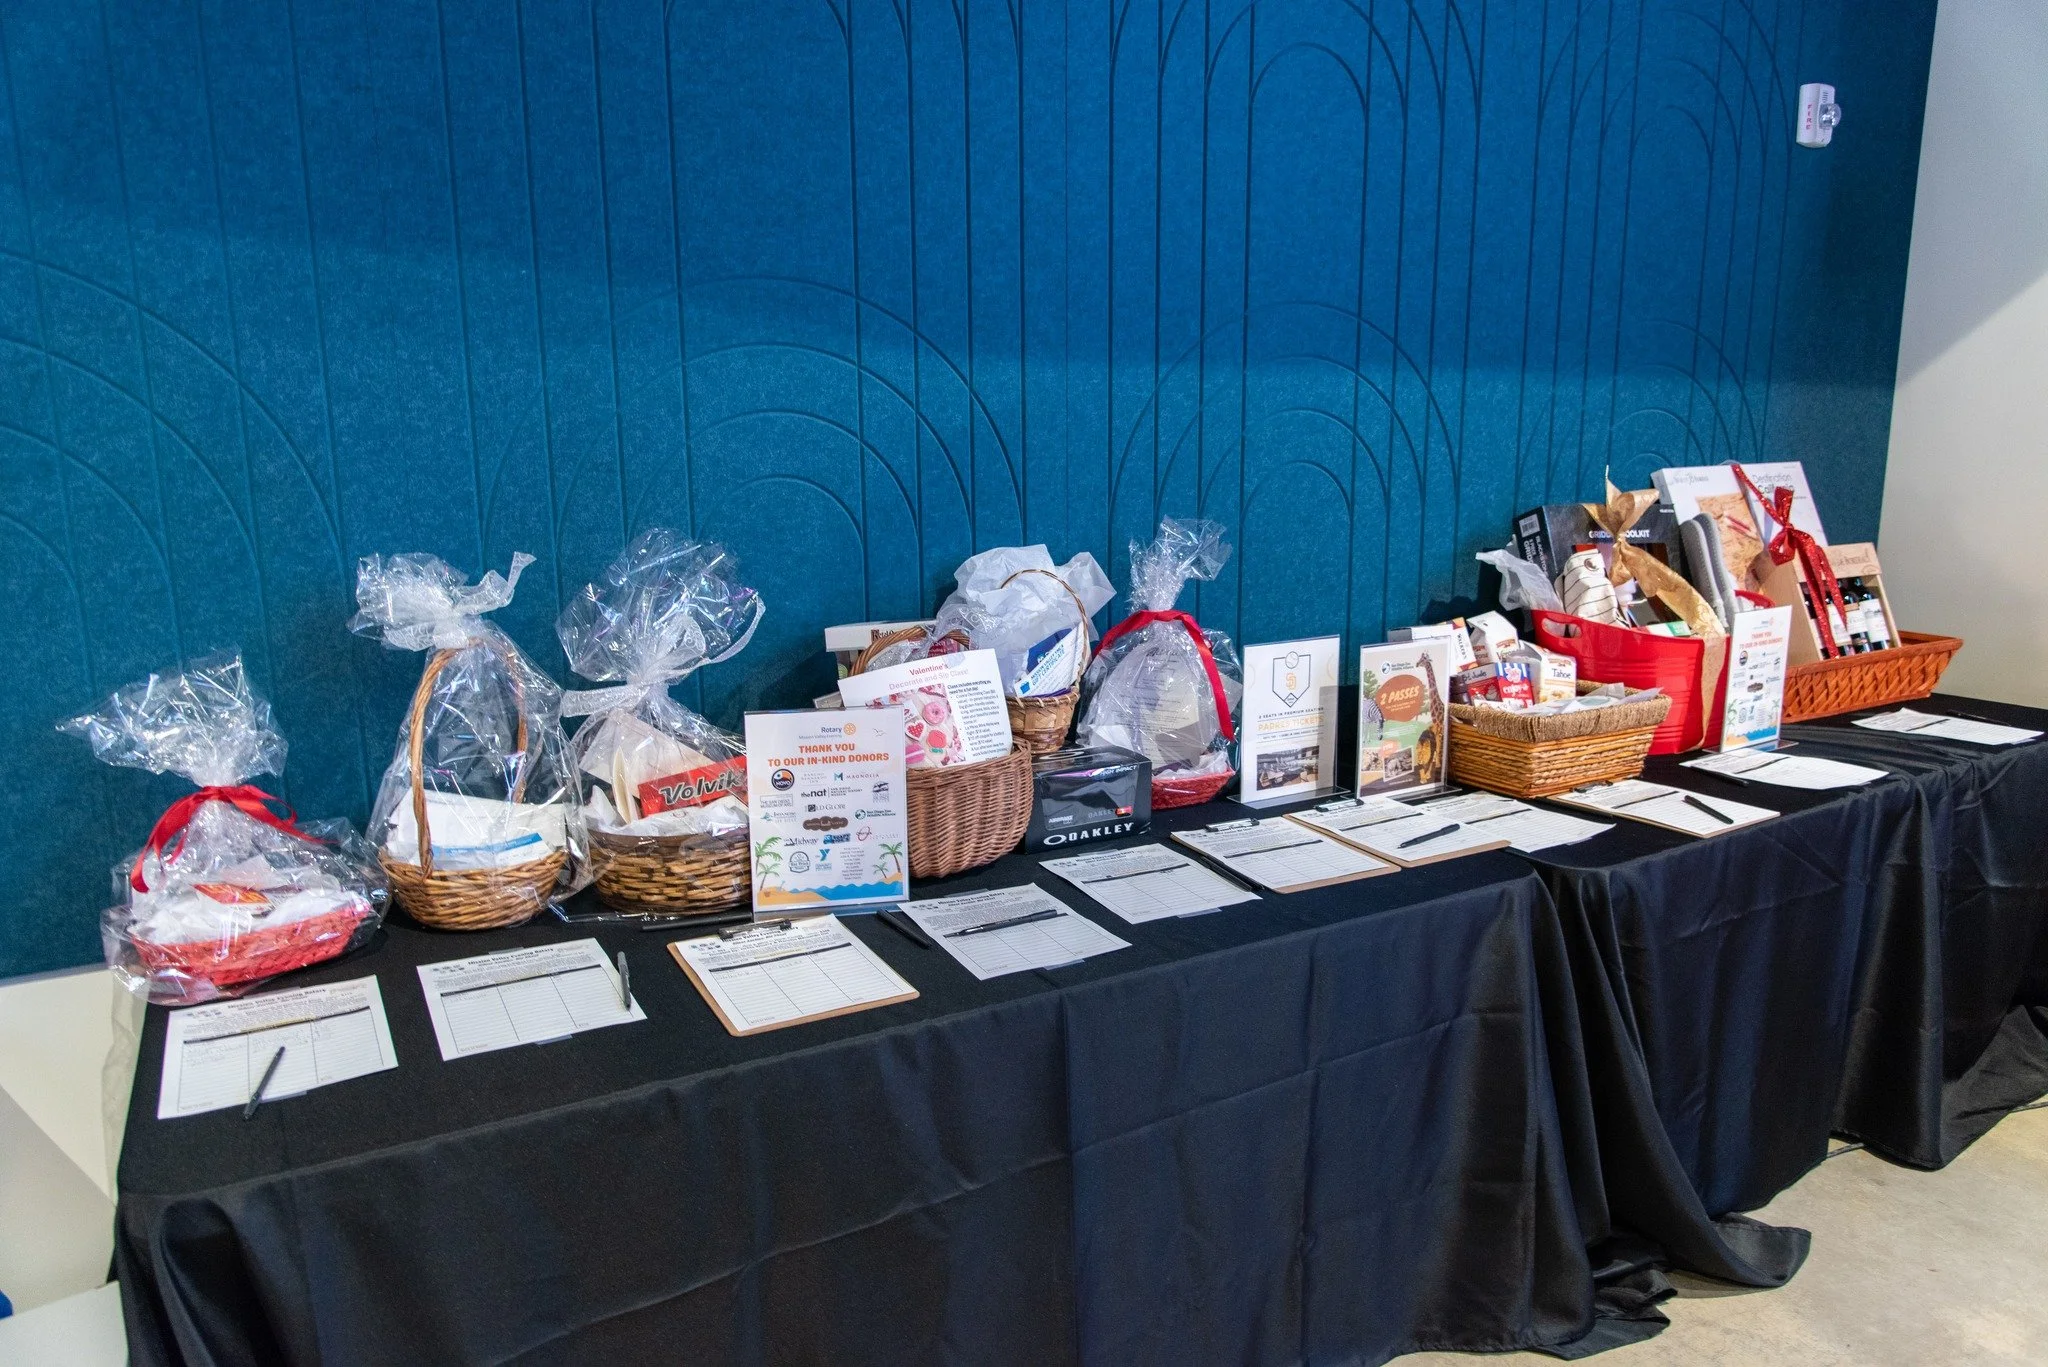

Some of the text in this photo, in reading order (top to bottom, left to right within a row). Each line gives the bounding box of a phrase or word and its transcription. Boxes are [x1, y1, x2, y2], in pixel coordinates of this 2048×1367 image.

[910, 663, 948, 676] Valentine's
[1552, 668, 1572, 679] Tahoe
[889, 677, 924, 690] Decorate
[924, 673, 938, 683] and
[938, 671, 950, 682] Sip
[1380, 686, 1420, 705] 2 PASSES
[1293, 715, 1324, 726] TICKETS
[799, 744, 855, 754] THANK YOU
[768, 753, 890, 767] TO OUR IN-KIND DONORS
[660, 769, 741, 806] Volvik
[1088, 808, 1112, 818] OAKLE
[1068, 822, 1134, 842] OAKLEY
